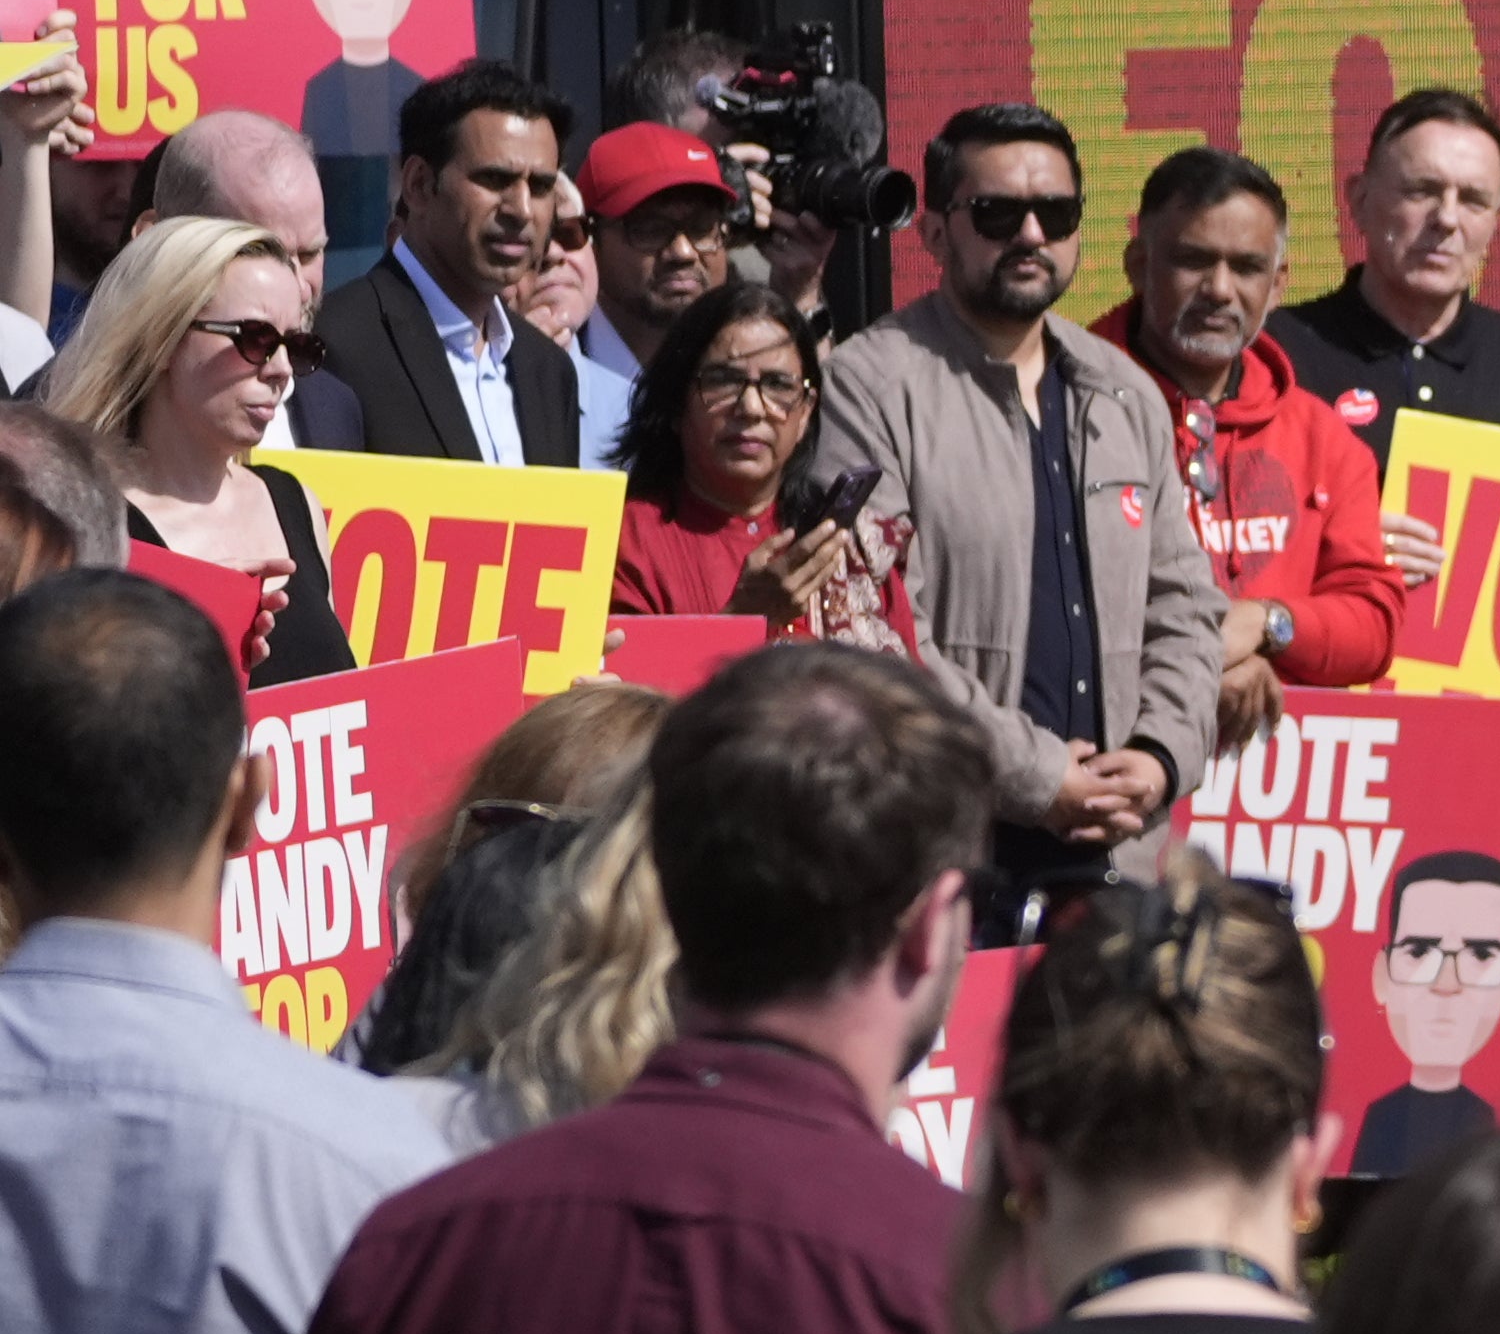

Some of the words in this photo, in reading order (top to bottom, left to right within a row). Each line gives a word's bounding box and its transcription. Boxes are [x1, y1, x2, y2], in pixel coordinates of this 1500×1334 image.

[96, 24, 199, 136] US
[322, 508, 588, 714] OTE
[240, 699, 374, 844] OTE
[220, 824, 388, 980] ANDY
